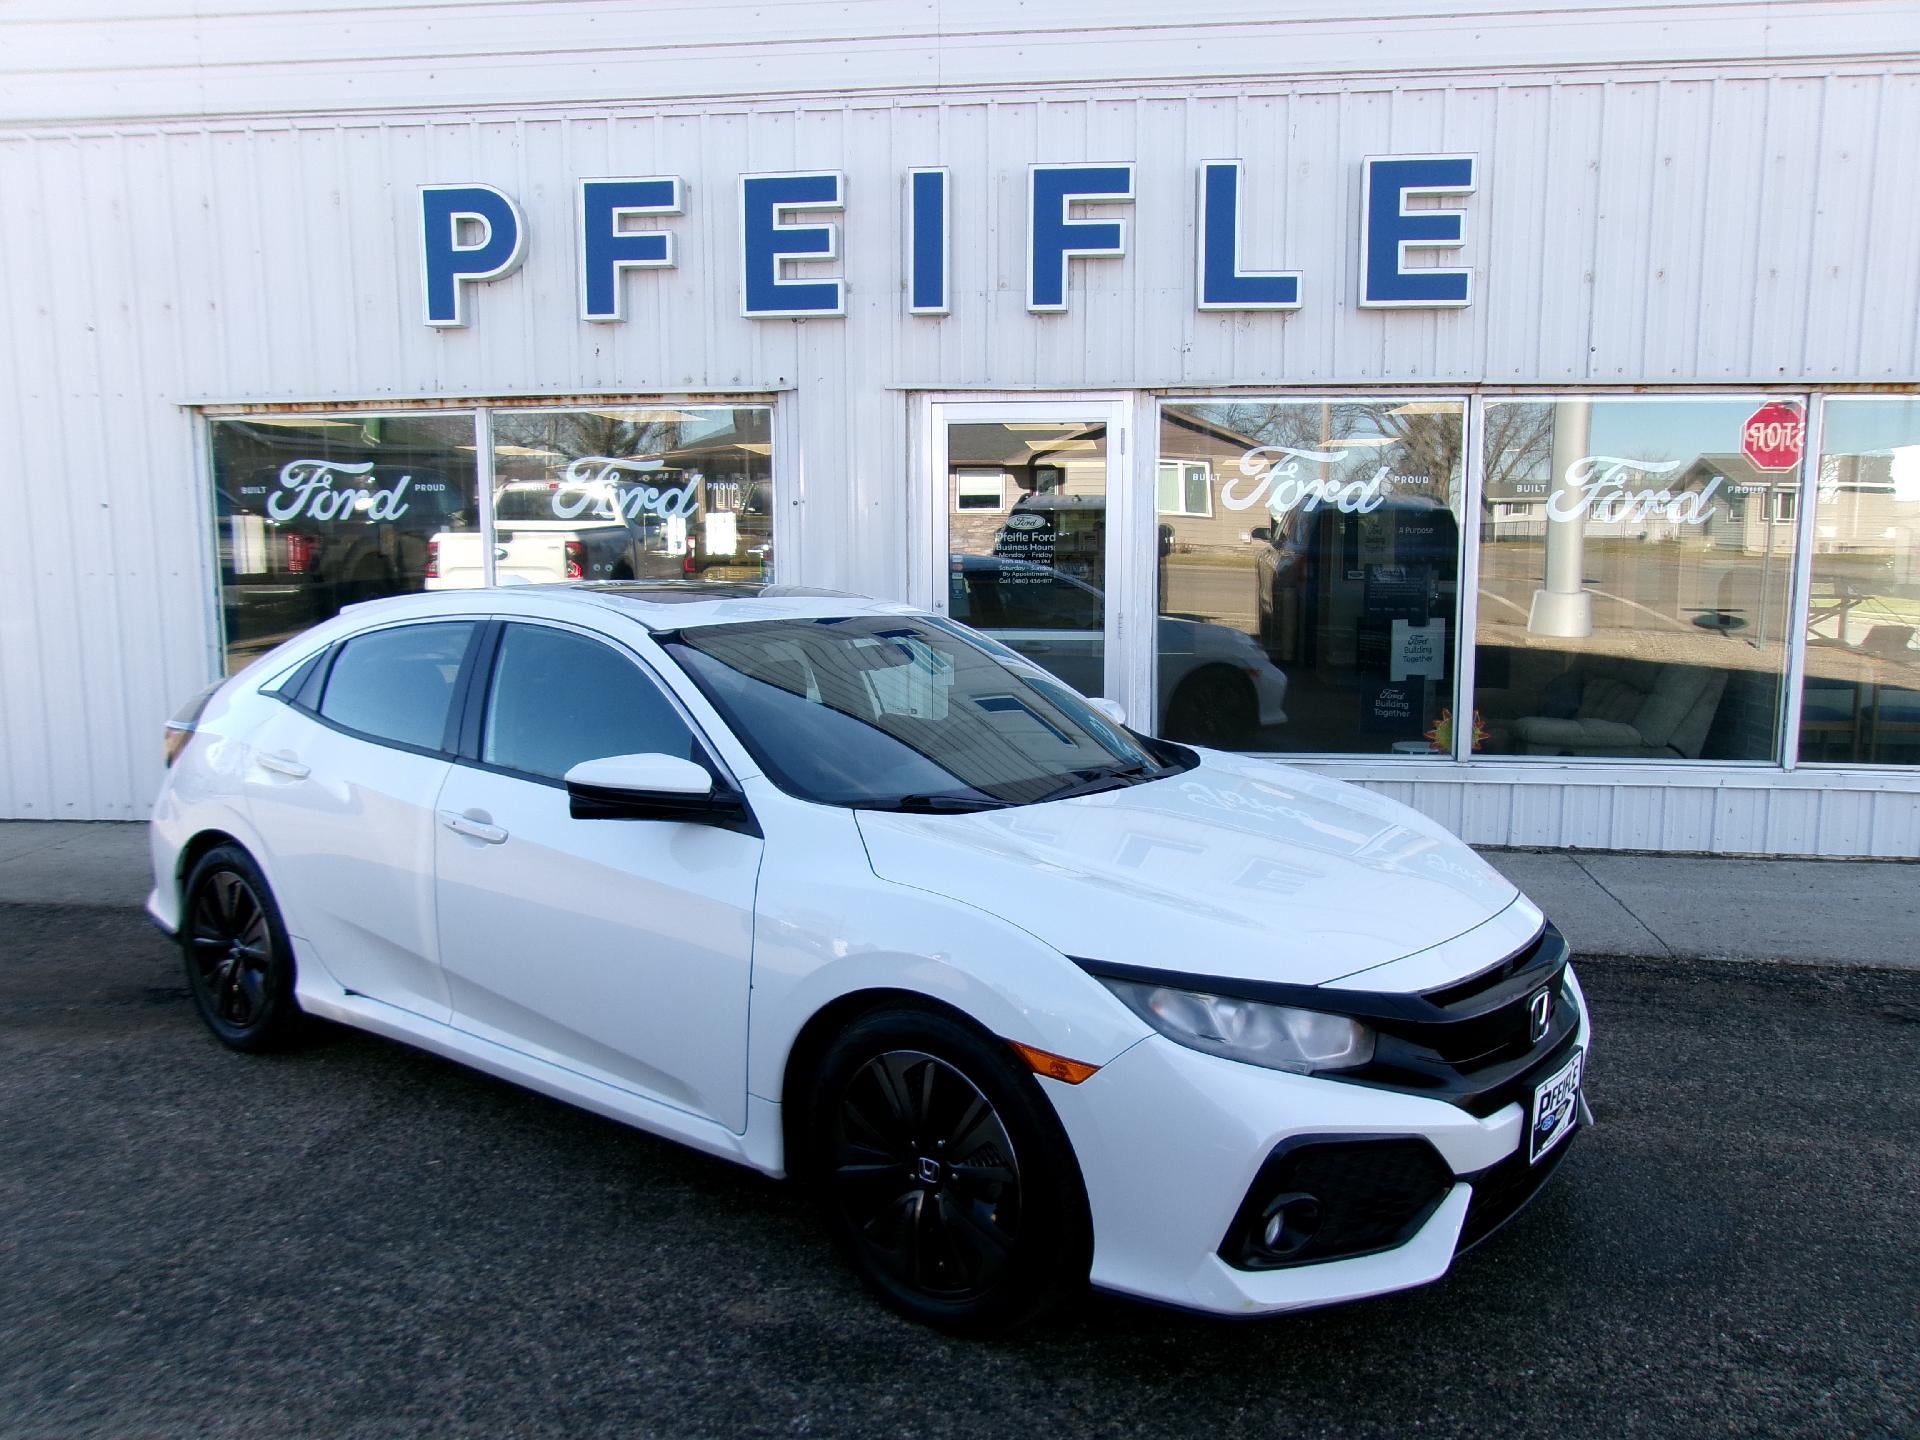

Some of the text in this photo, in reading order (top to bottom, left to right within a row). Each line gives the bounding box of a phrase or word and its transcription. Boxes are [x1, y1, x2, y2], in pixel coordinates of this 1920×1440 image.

[417, 153, 1479, 329] PFEIFLE
[1192, 445, 1430, 514] BULT Ford PROUD
[240, 459, 446, 521] BUILT Ford PROUD
[551, 456, 739, 519] Ford PROUD
[1516, 455, 1765, 525] BUILT Ford PROUD
[1404, 526, 1434, 535] Purpose
[995, 532, 1056, 542] Pfeifle Ford
[996, 543, 1029, 551] Business
[1407, 634, 1429, 646] Ford
[1404, 646, 1432, 655] Building
[1402, 655, 1433, 664] Together
[1378, 688, 1406, 700] Ford
[1375, 699, 1409, 710] Building
[1374, 708, 1411, 718] Together
